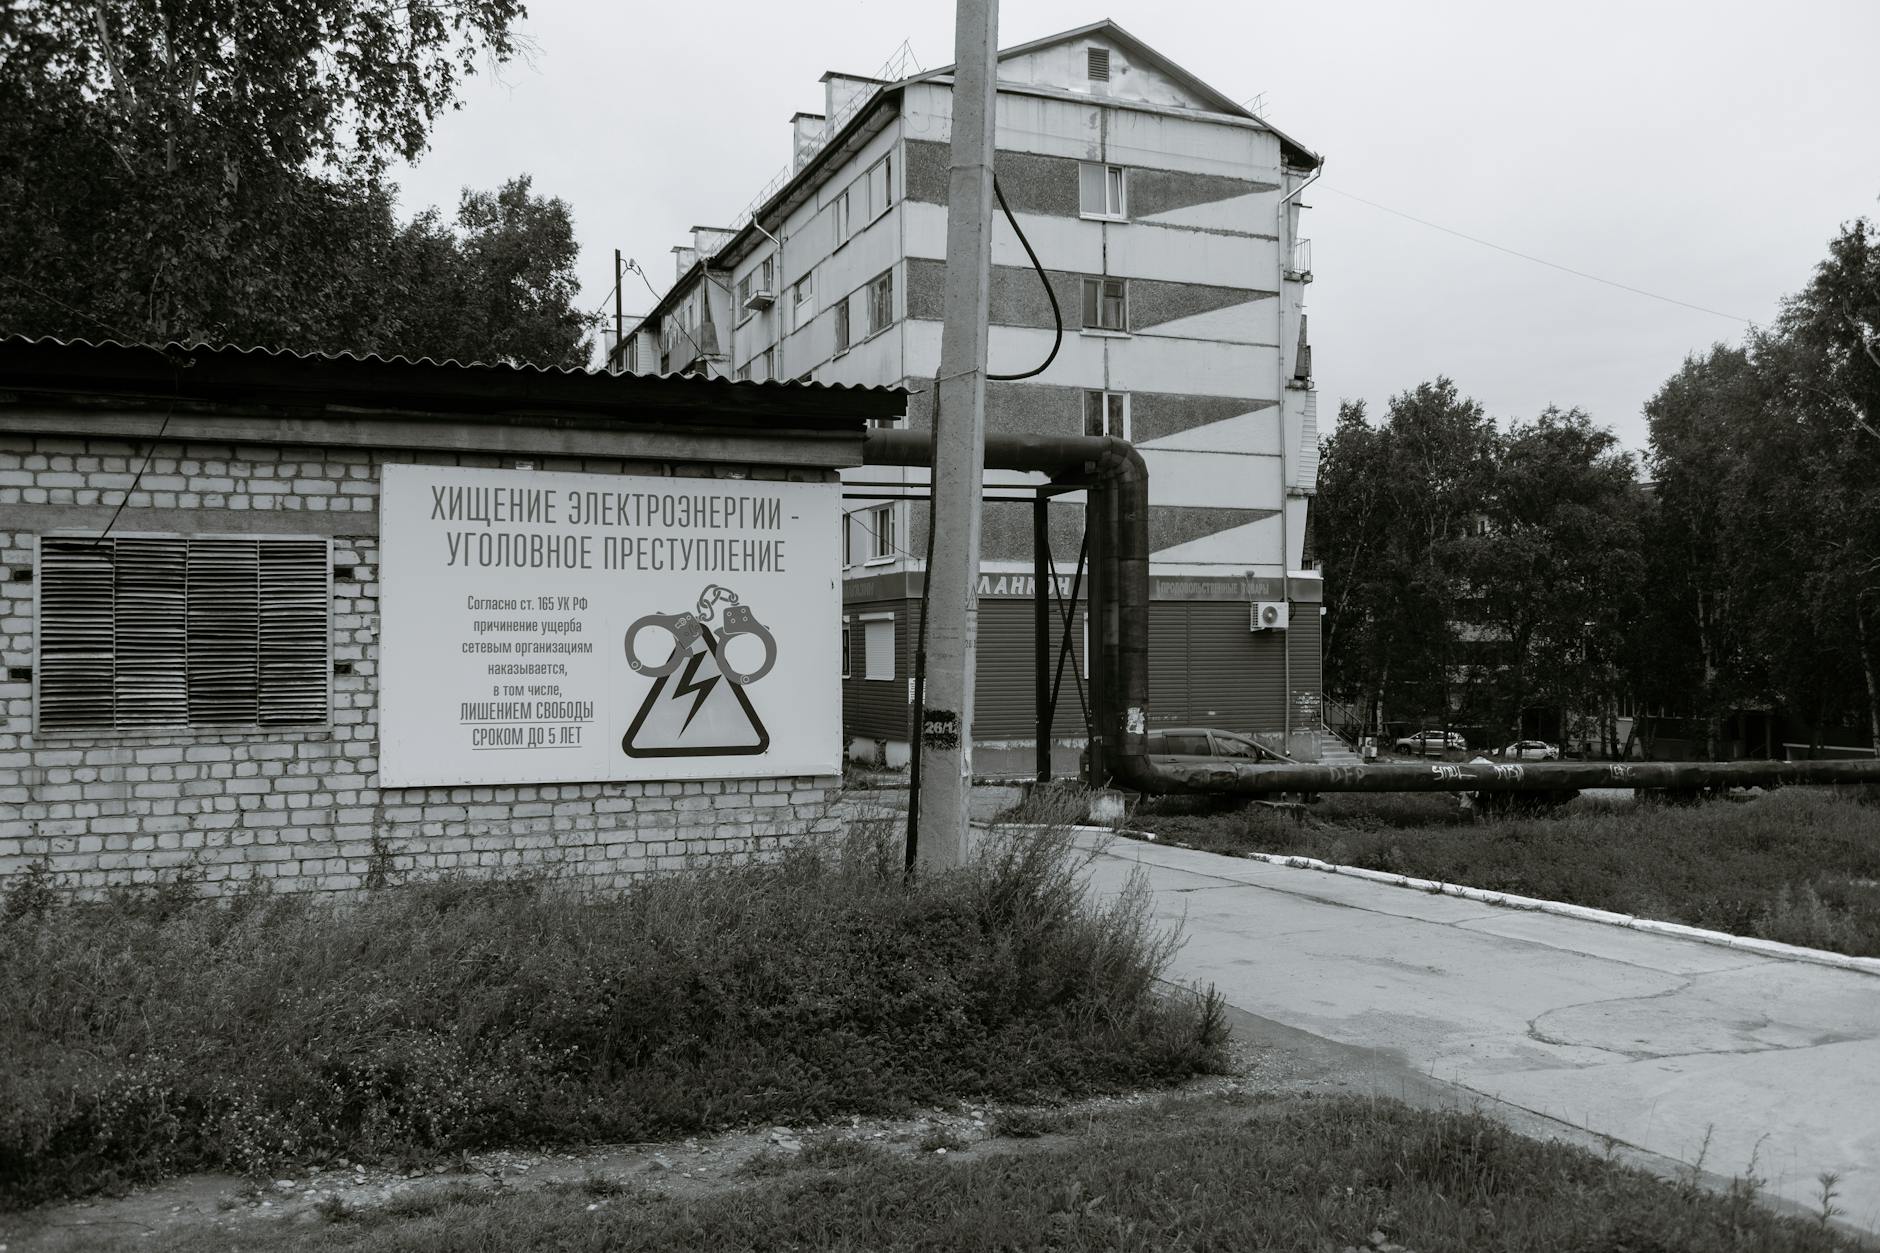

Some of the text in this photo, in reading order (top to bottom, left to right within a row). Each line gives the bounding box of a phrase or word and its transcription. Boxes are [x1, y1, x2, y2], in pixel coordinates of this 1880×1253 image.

[431, 485, 557, 527] ХИЩЕНИЕ
[568, 491, 781, 530] ЭЛЕКТРОЭНЕРГИИ
[447, 532, 786, 572] УГОЛОВНОЕ ПРЕСТУПЛЕНИЕ
[467, 595, 588, 611] Согласно ст. 165 УК РФ
[473, 617, 582, 635] причинение ущерба
[462, 642, 593, 656] сетевым организациям
[488, 664, 568, 676] наказывается,
[493, 685, 562, 697] в том числе,
[460, 701, 594, 722] ЛИШЕНИЕМ СВОБОДЫ
[472, 726, 582, 748] СРОКОМ ДО 5 ЛЕТ
